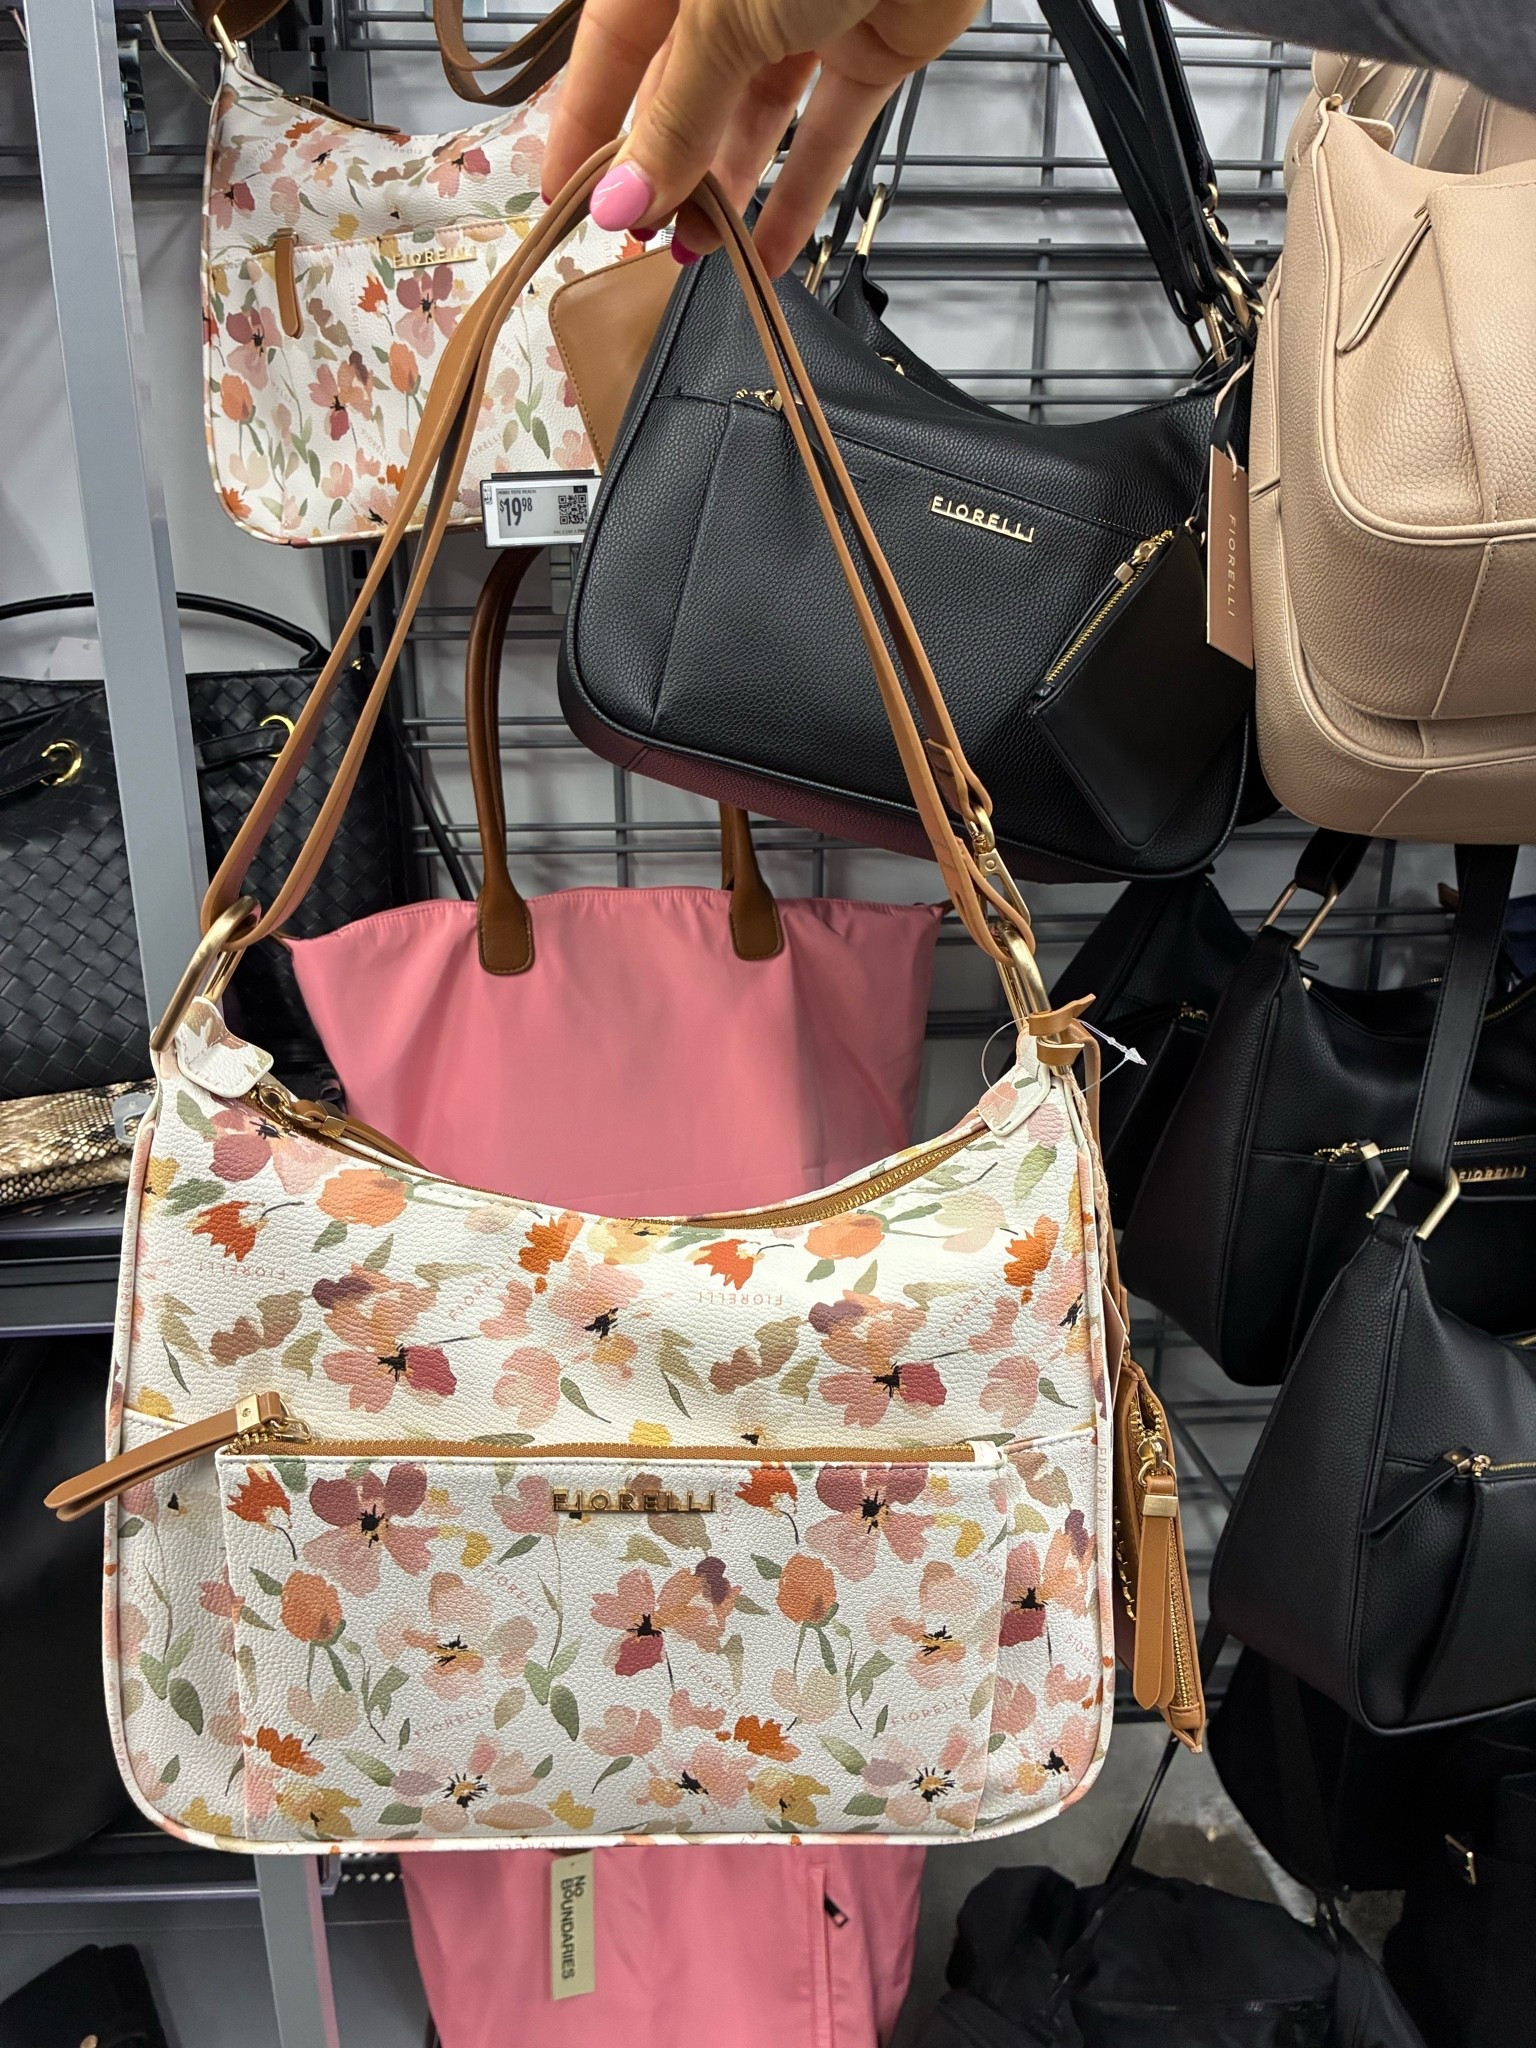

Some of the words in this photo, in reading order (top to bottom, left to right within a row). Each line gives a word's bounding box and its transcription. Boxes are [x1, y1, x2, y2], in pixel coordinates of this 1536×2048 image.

[930, 494, 1035, 543] FIORELLI
[1227, 513, 1237, 618] FIORELLI
[1458, 1166, 1527, 1183] FIORELLI
[699, 1291, 783, 1306] FIORELLI
[553, 1488, 716, 1512] FIORELLI
[482, 1563, 549, 1618] FIORELLI
[560, 1878, 576, 1981] BOUNDARIES
